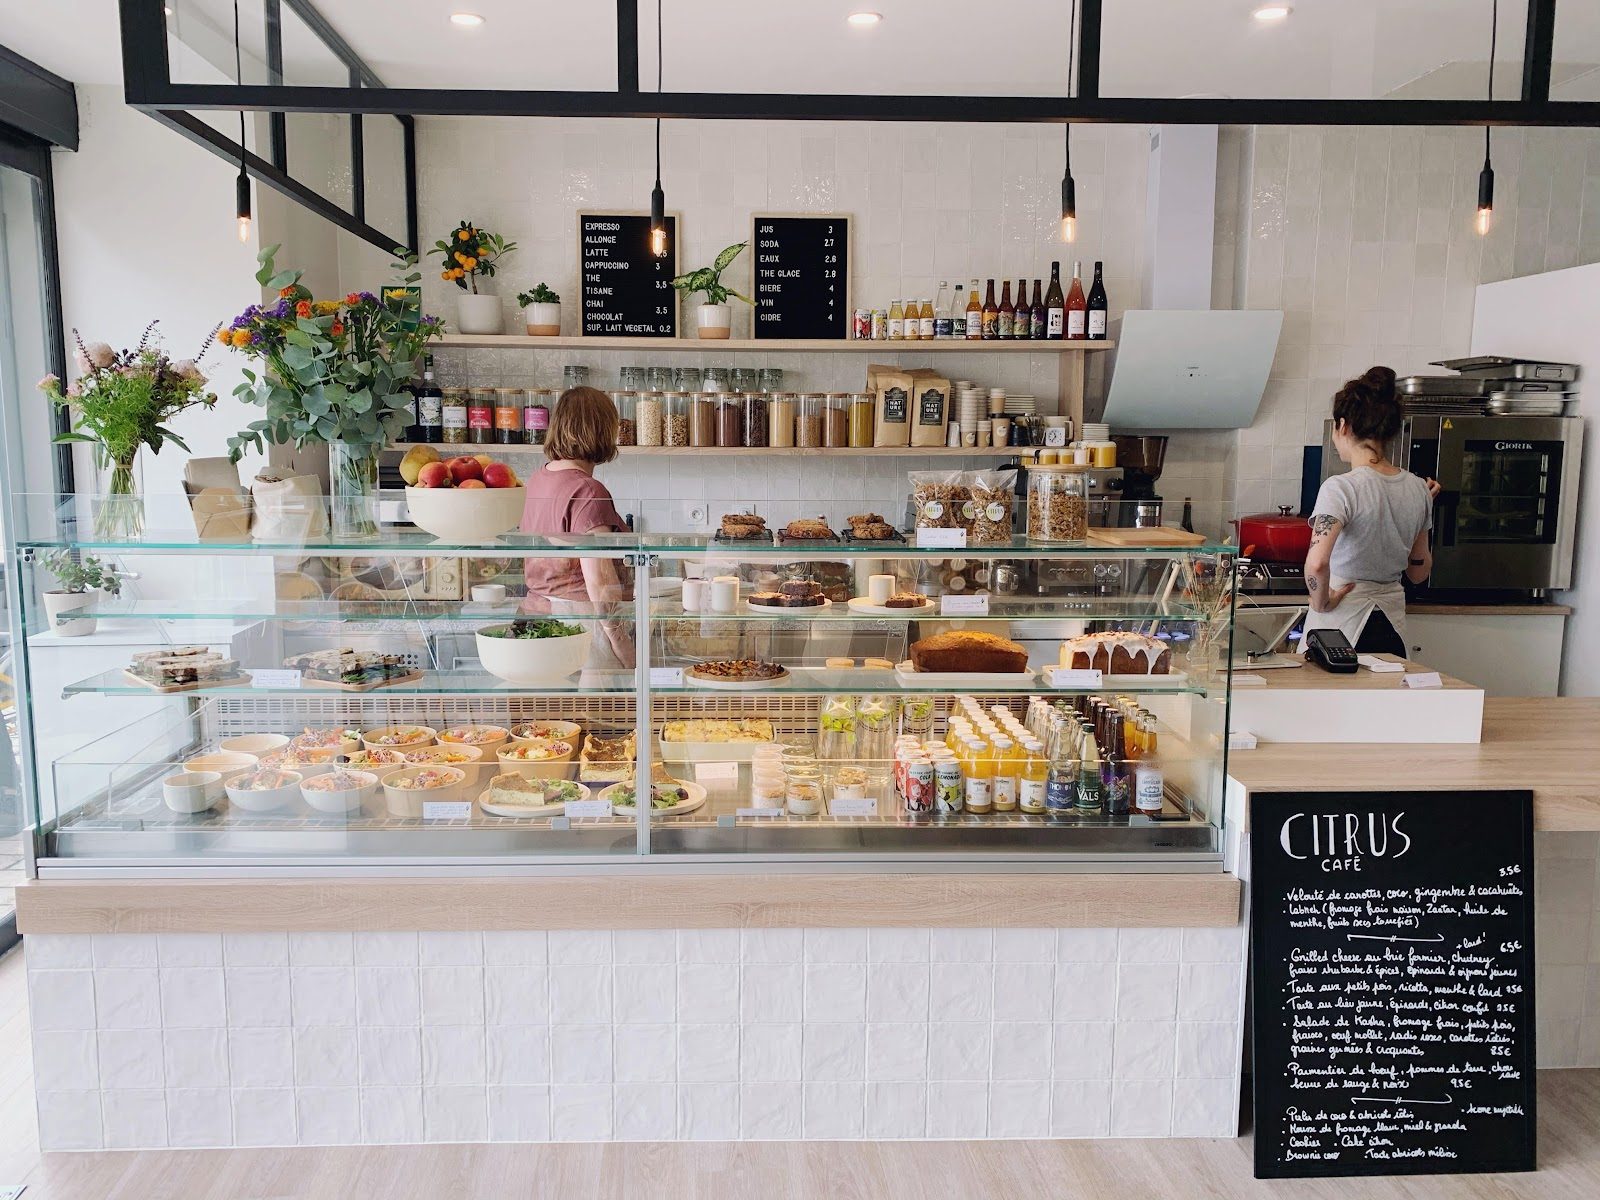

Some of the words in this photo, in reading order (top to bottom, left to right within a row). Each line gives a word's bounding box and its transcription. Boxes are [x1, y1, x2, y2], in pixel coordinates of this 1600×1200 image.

[585, 222, 620, 231] EXPRESSO
[760, 225, 774, 234] JUS
[828, 226, 833, 234] 3
[585, 236, 617, 244] ALLONGE
[760, 240, 779, 248] SODA
[585, 248, 609, 257] LATTE
[760, 255, 780, 263] EAUX
[585, 261, 630, 270] CAPPUCCINO
[655, 262, 661, 270] 3
[586, 274, 601, 282] THE
[760, 269, 775, 278] THE
[778, 269, 800, 278] GLACE
[586, 286, 613, 295] TISANE
[760, 284, 781, 292] BIERE
[829, 284, 834, 292] 4
[586, 300, 604, 308] CHAI
[761, 299, 774, 307] VIN
[829, 299, 833, 307] 4
[586, 313, 623, 321] CHOCOLAT
[760, 313, 781, 321] CIDRE
[828, 313, 833, 321] 4
[586, 323, 603, 332] SUP.
[605, 324, 622, 332] LAIT
[625, 324, 656, 333] VEGETAL
[1494, 441, 1533, 450] GIORIK
[1077, 787, 1100, 801] VALS
[1280, 812, 1411, 859] CITRUS
[1321, 856, 1362, 872] CAFÉ
[1287, 887, 1324, 901] Velouté
[1326, 889, 1341, 900] de
[1414, 885, 1466, 903] gingembre
[1468, 885, 1475, 896] &
[1366, 900, 1388, 916] frais
[1491, 905, 1508, 916] de
[1291, 947, 1329, 962] Grilled
[1332, 947, 1361, 962] cheese
[1364, 954, 1381, 962] au
[1383, 947, 1405, 961] brie
[1452, 951, 1496, 969] chutney
[1366, 964, 1373, 975] &
[1448, 965, 1455, 976] &
[1286, 979, 1315, 993] Tarte
[1319, 983, 1341, 992] aux
[1344, 980, 1370, 994] petits
[1435, 983, 1468, 995] menthe
[1468, 985, 1475, 996] &
[1477, 983, 1503, 997] lard
[1286, 996, 1315, 1010] Tarte
[1317, 1001, 1333, 1009] au
[1335, 996, 1355, 1008] lieu
[1334, 1015, 1350, 1027] de
[1393, 1014, 1433, 1031] fromage
[1465, 1018, 1490, 1033] petits
[1365, 1042, 1373, 1054] &
[1287, 1062, 1346, 1075] Parmentier
[1349, 1064, 1365, 1075] de
[1446, 1063, 1461, 1074] de
[1325, 1078, 1339, 1089] de
[1371, 1078, 1379, 1089] &
[1315, 1110, 1328, 1120] de
[1349, 1110, 1357, 1120] &
[1319, 1123, 1332, 1133] de
[1336, 1122, 1371, 1138] fromage
[1425, 1120, 1432, 1130] &
[1341, 1134, 1364, 1147] Cake
[1285, 1149, 1321, 1161] Brownie
